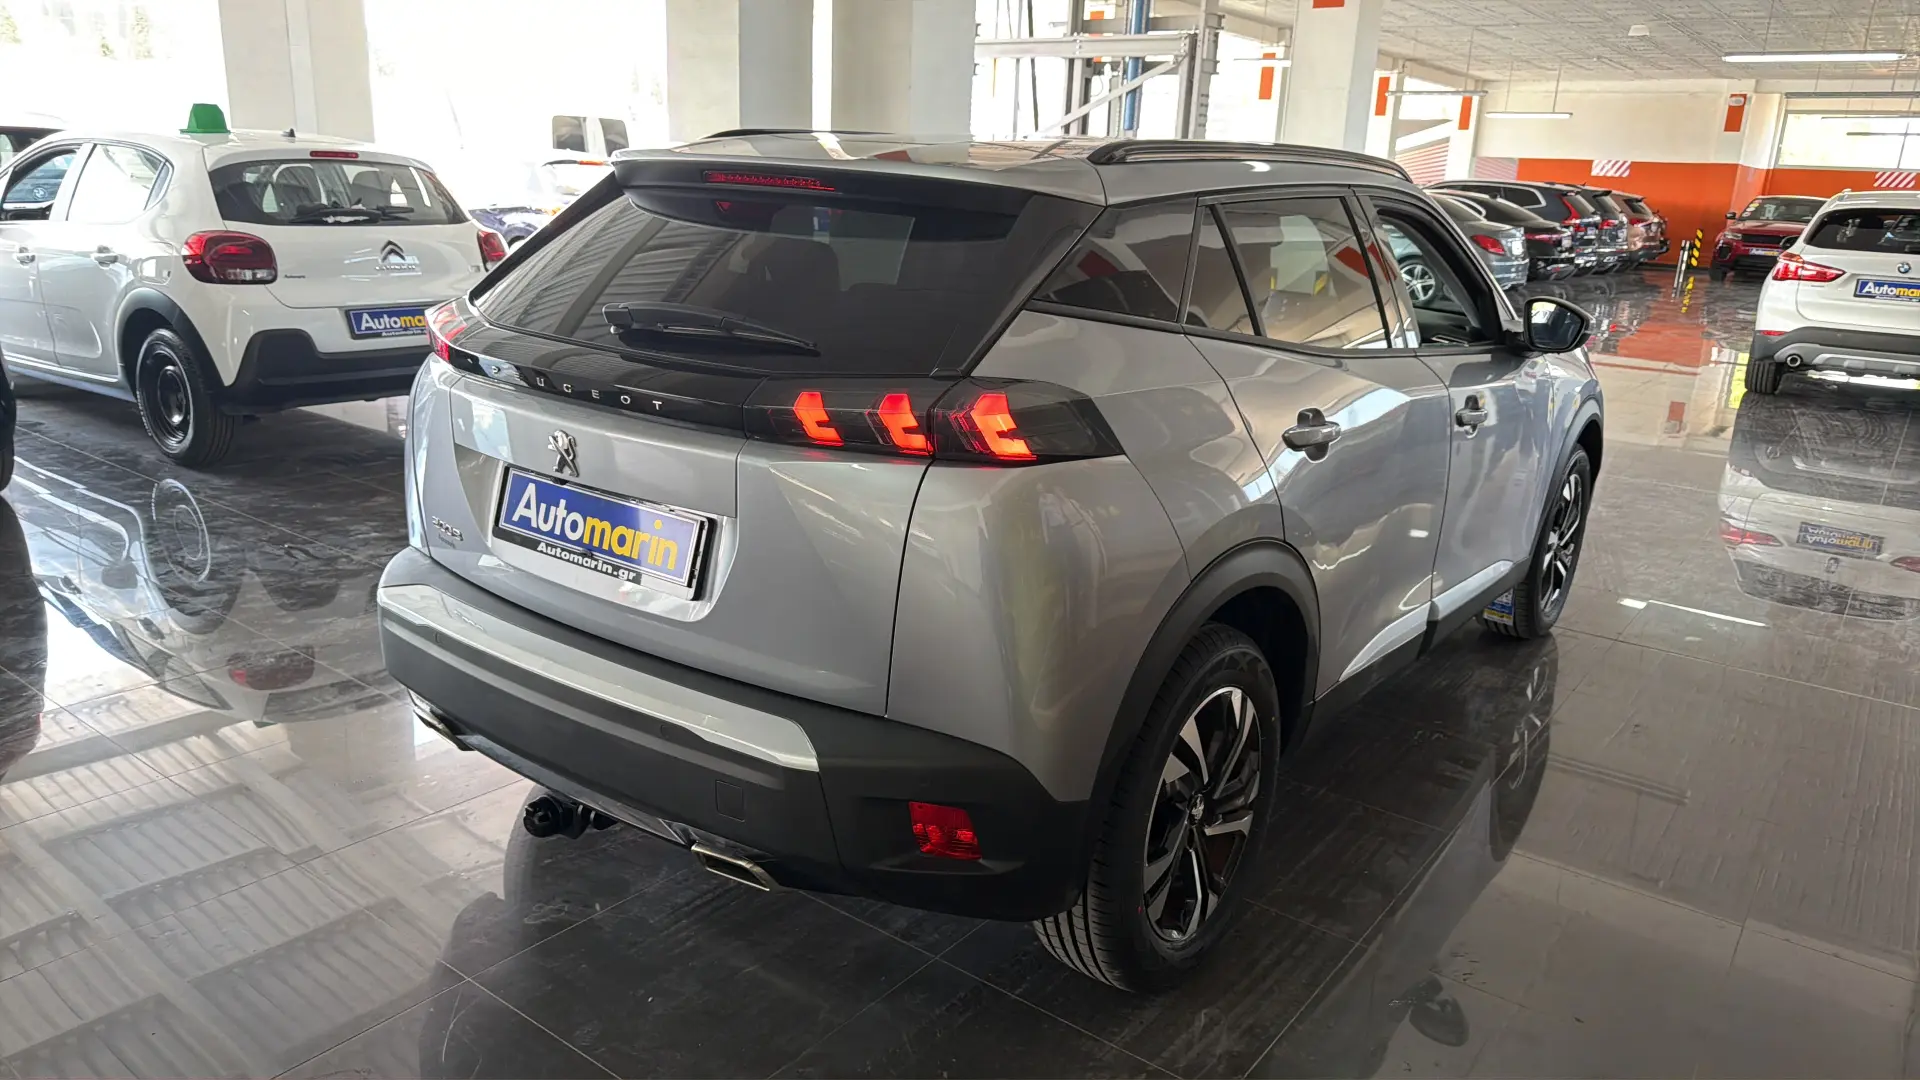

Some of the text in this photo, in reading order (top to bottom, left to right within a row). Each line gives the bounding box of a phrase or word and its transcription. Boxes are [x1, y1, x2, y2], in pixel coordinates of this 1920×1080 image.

[361, 312, 427, 330] Automa
[512, 482, 678, 571] Automarin
[536, 541, 637, 581] Automarin.gr
